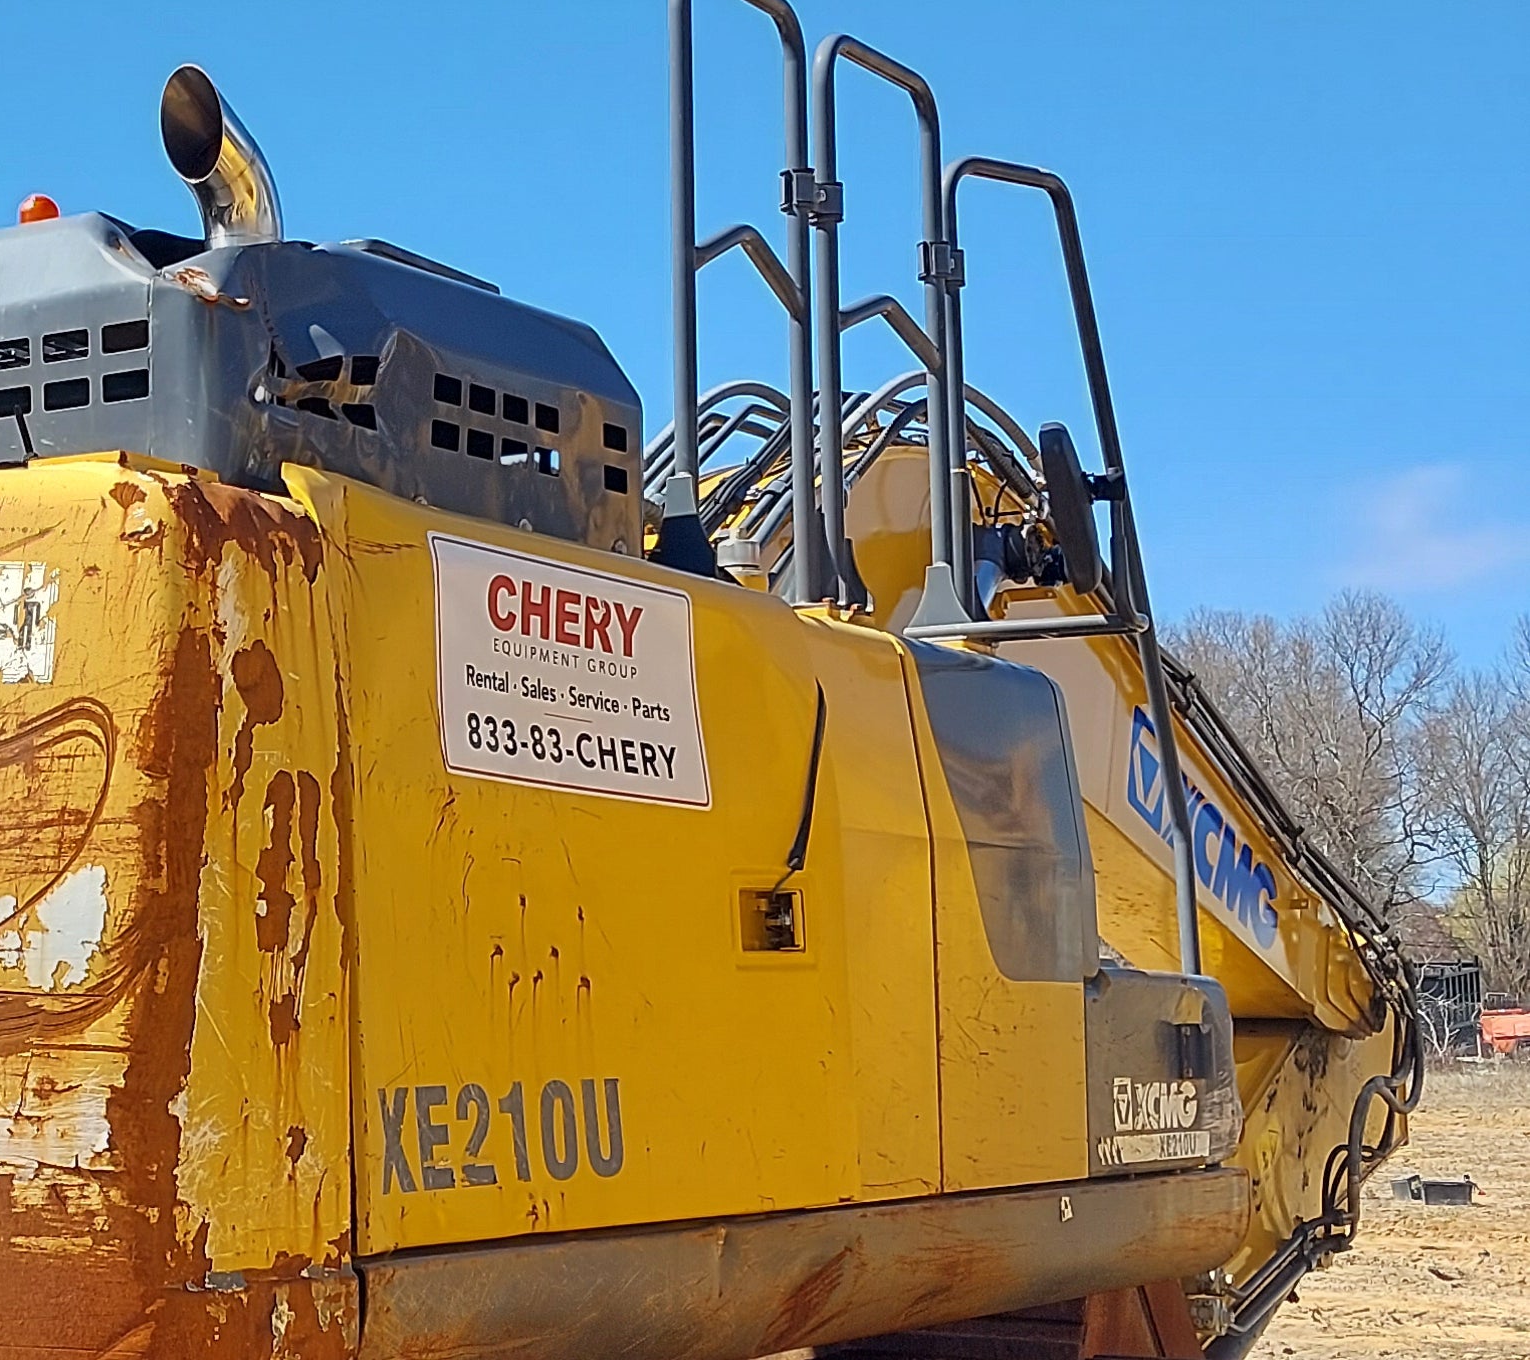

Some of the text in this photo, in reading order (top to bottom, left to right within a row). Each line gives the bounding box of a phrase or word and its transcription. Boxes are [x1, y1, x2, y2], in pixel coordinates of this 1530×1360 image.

[488, 574, 643, 658] CHERY
[493, 638, 638, 679] EQUIPMENT GROUP
[466, 664, 670, 722] Rental Sales Service Parts
[467, 712, 677, 779] 833-83-CHERY
[377, 1078, 624, 1195] XE210U
[1133, 1081, 1198, 1131] XCMG
